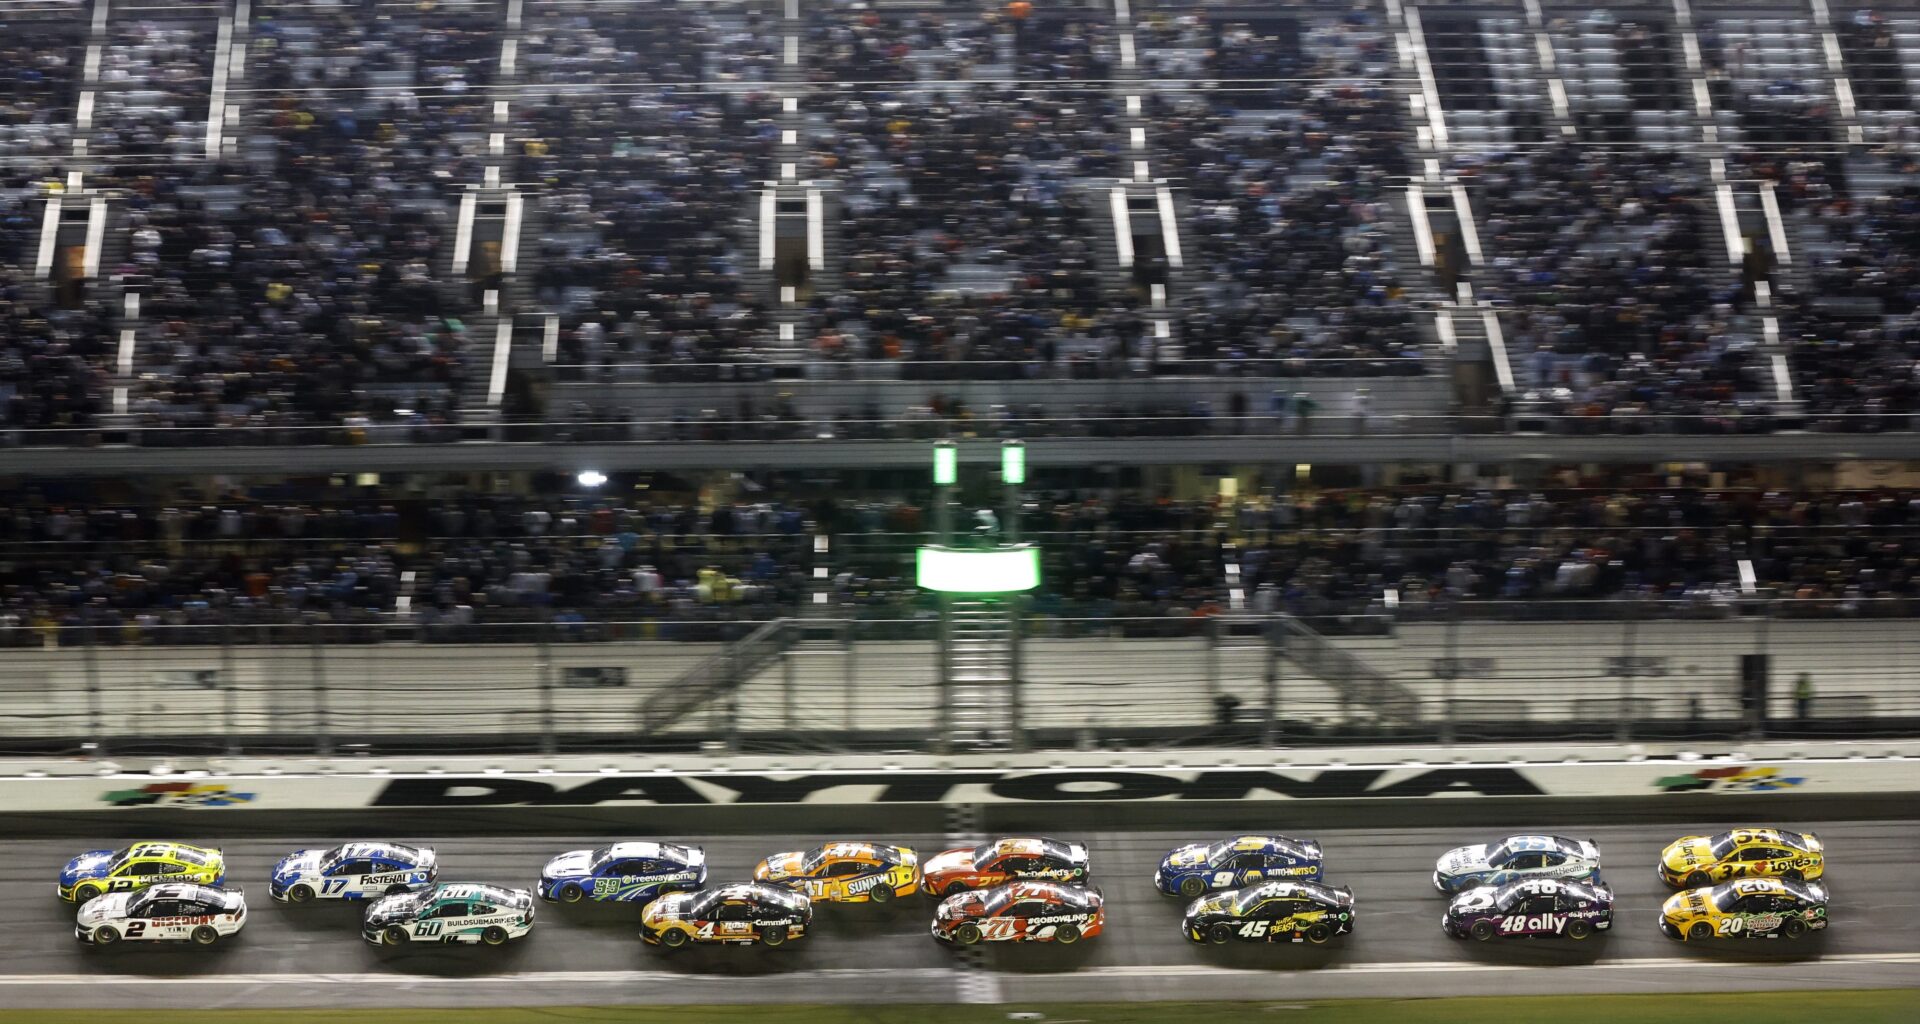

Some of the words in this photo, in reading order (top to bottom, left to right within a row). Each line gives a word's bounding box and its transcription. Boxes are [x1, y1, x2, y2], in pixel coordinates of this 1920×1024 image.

[369, 768, 1548, 805] DAYTONA
[139, 874, 202, 883] MENARDS
[360, 874, 407, 885] FASTENAL
[1212, 871, 1235, 888] 9
[1718, 864, 1747, 880] 34
[319, 879, 349, 896] 17
[593, 878, 622, 895] 99
[805, 880, 824, 897] 47
[756, 918, 792, 927] Cummins
[1028, 914, 1087, 924] #GOBOWLING
[1500, 916, 1526, 932] 48
[1528, 912, 1567, 934] ally
[1718, 917, 1743, 934] 20
[125, 921, 146, 938] 2
[414, 922, 443, 937] 60
[697, 921, 715, 939] 4
[1238, 921, 1270, 938] 45
[1270, 922, 1299, 936] BEAST
